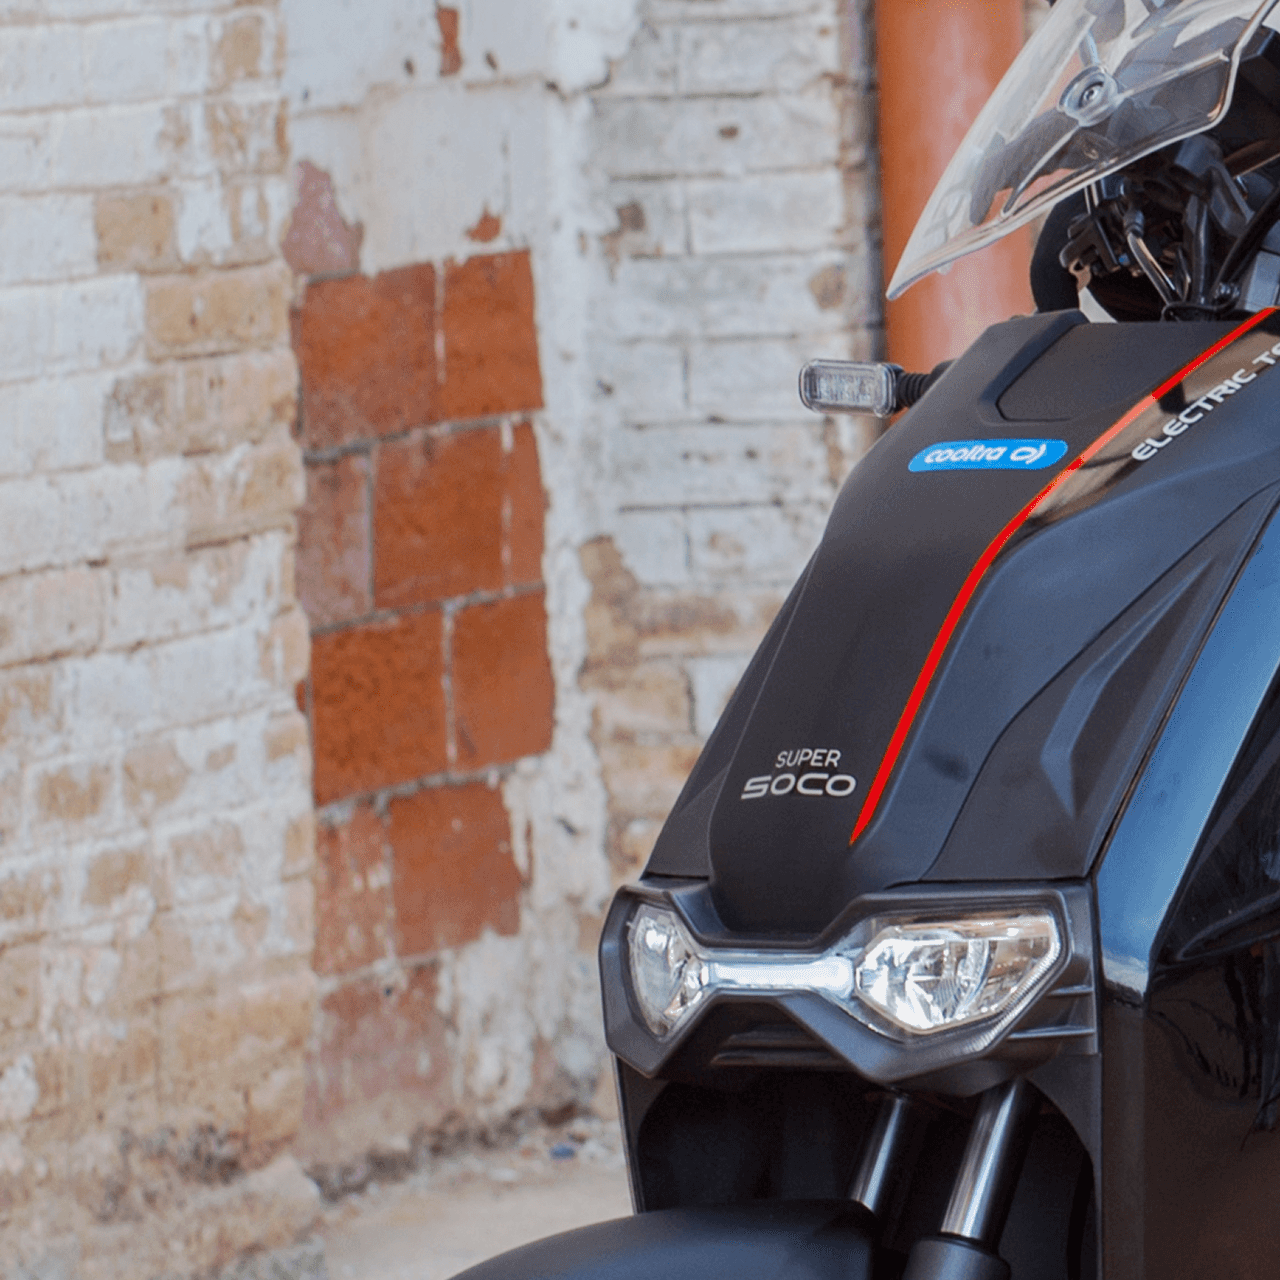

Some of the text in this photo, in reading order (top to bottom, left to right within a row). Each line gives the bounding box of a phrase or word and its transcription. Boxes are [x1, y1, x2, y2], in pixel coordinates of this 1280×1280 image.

[1131, 368, 1257, 461] ELECTRIC
[924, 444, 1008, 464] cooltra
[775, 748, 841, 768] SUPER
[741, 772, 857, 799] SOCO
